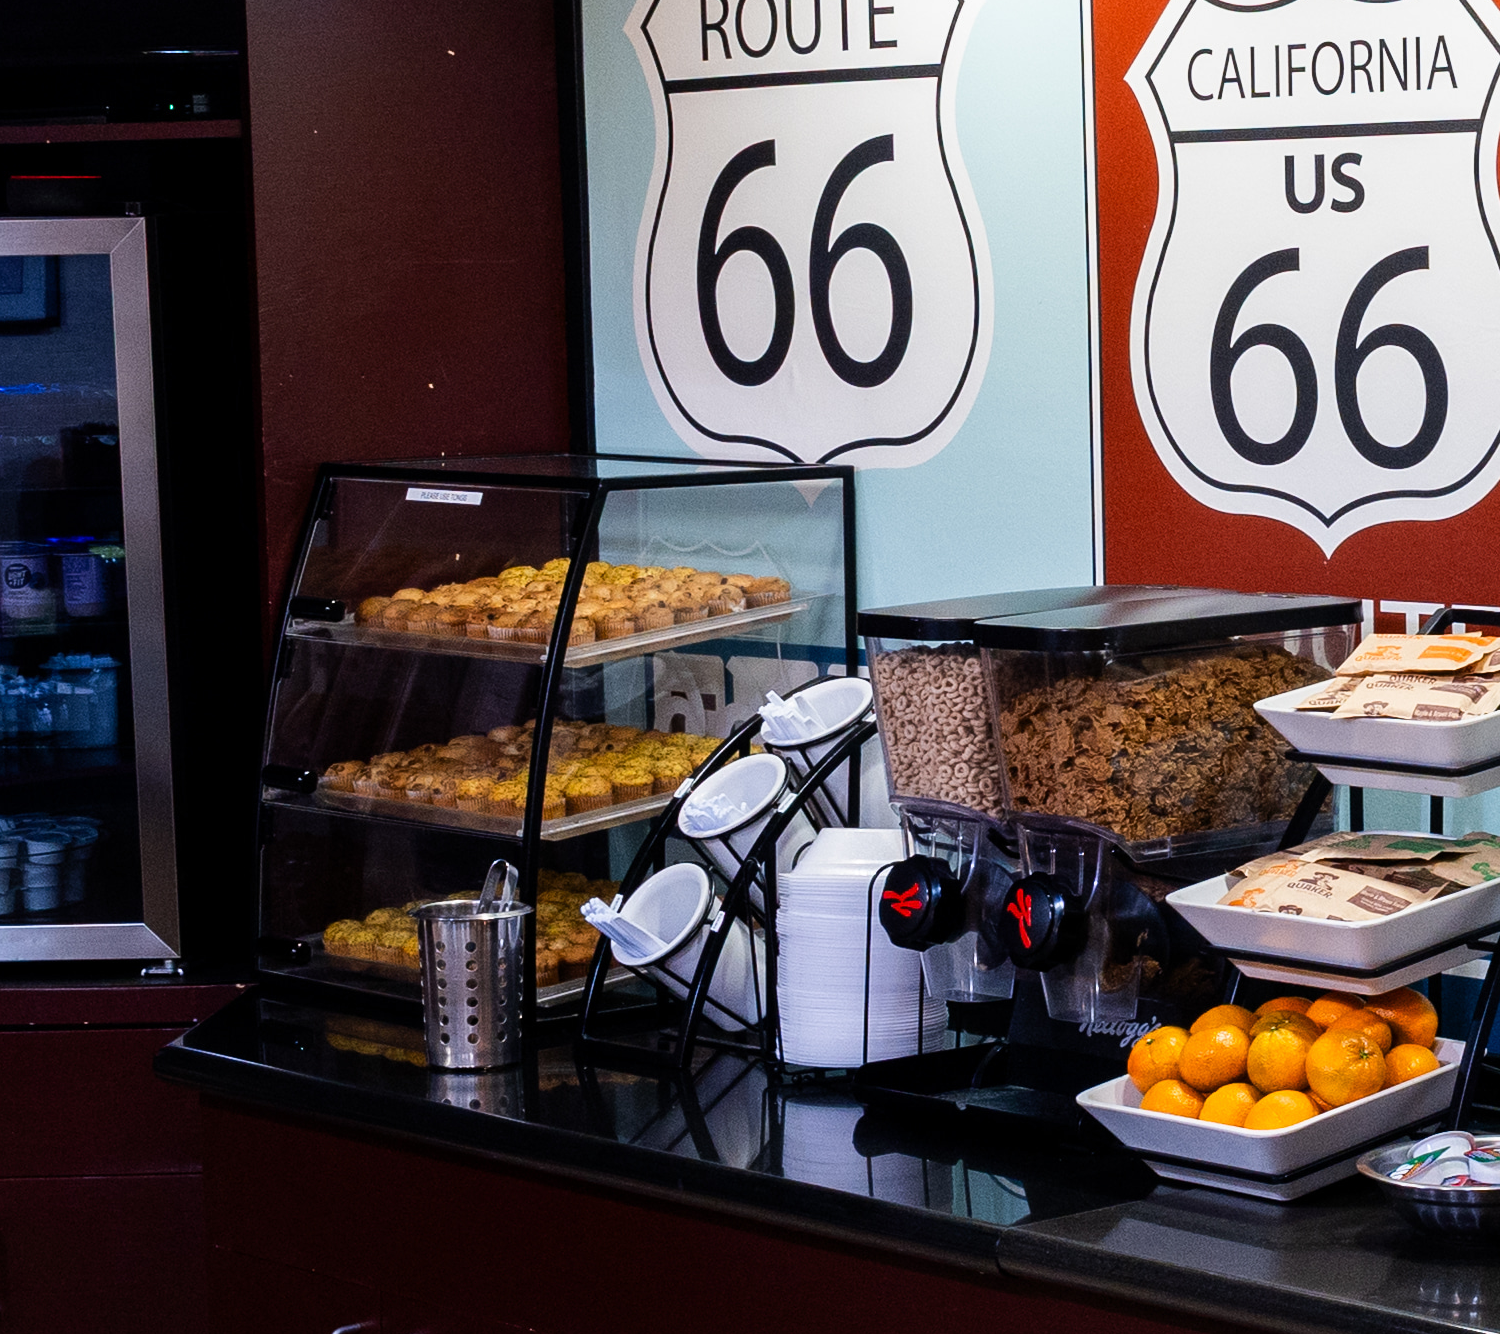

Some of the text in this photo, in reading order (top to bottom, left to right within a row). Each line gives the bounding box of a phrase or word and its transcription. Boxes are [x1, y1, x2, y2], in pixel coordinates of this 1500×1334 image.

[1185, 34, 1458, 101] CALIFORNIA
[1282, 152, 1366, 214] US
[697, 133, 914, 388] 66
[1209, 243, 1450, 471] 66
[1388, 673, 1438, 686] QUAKER
[1286, 881, 1333, 899] QUAKER
